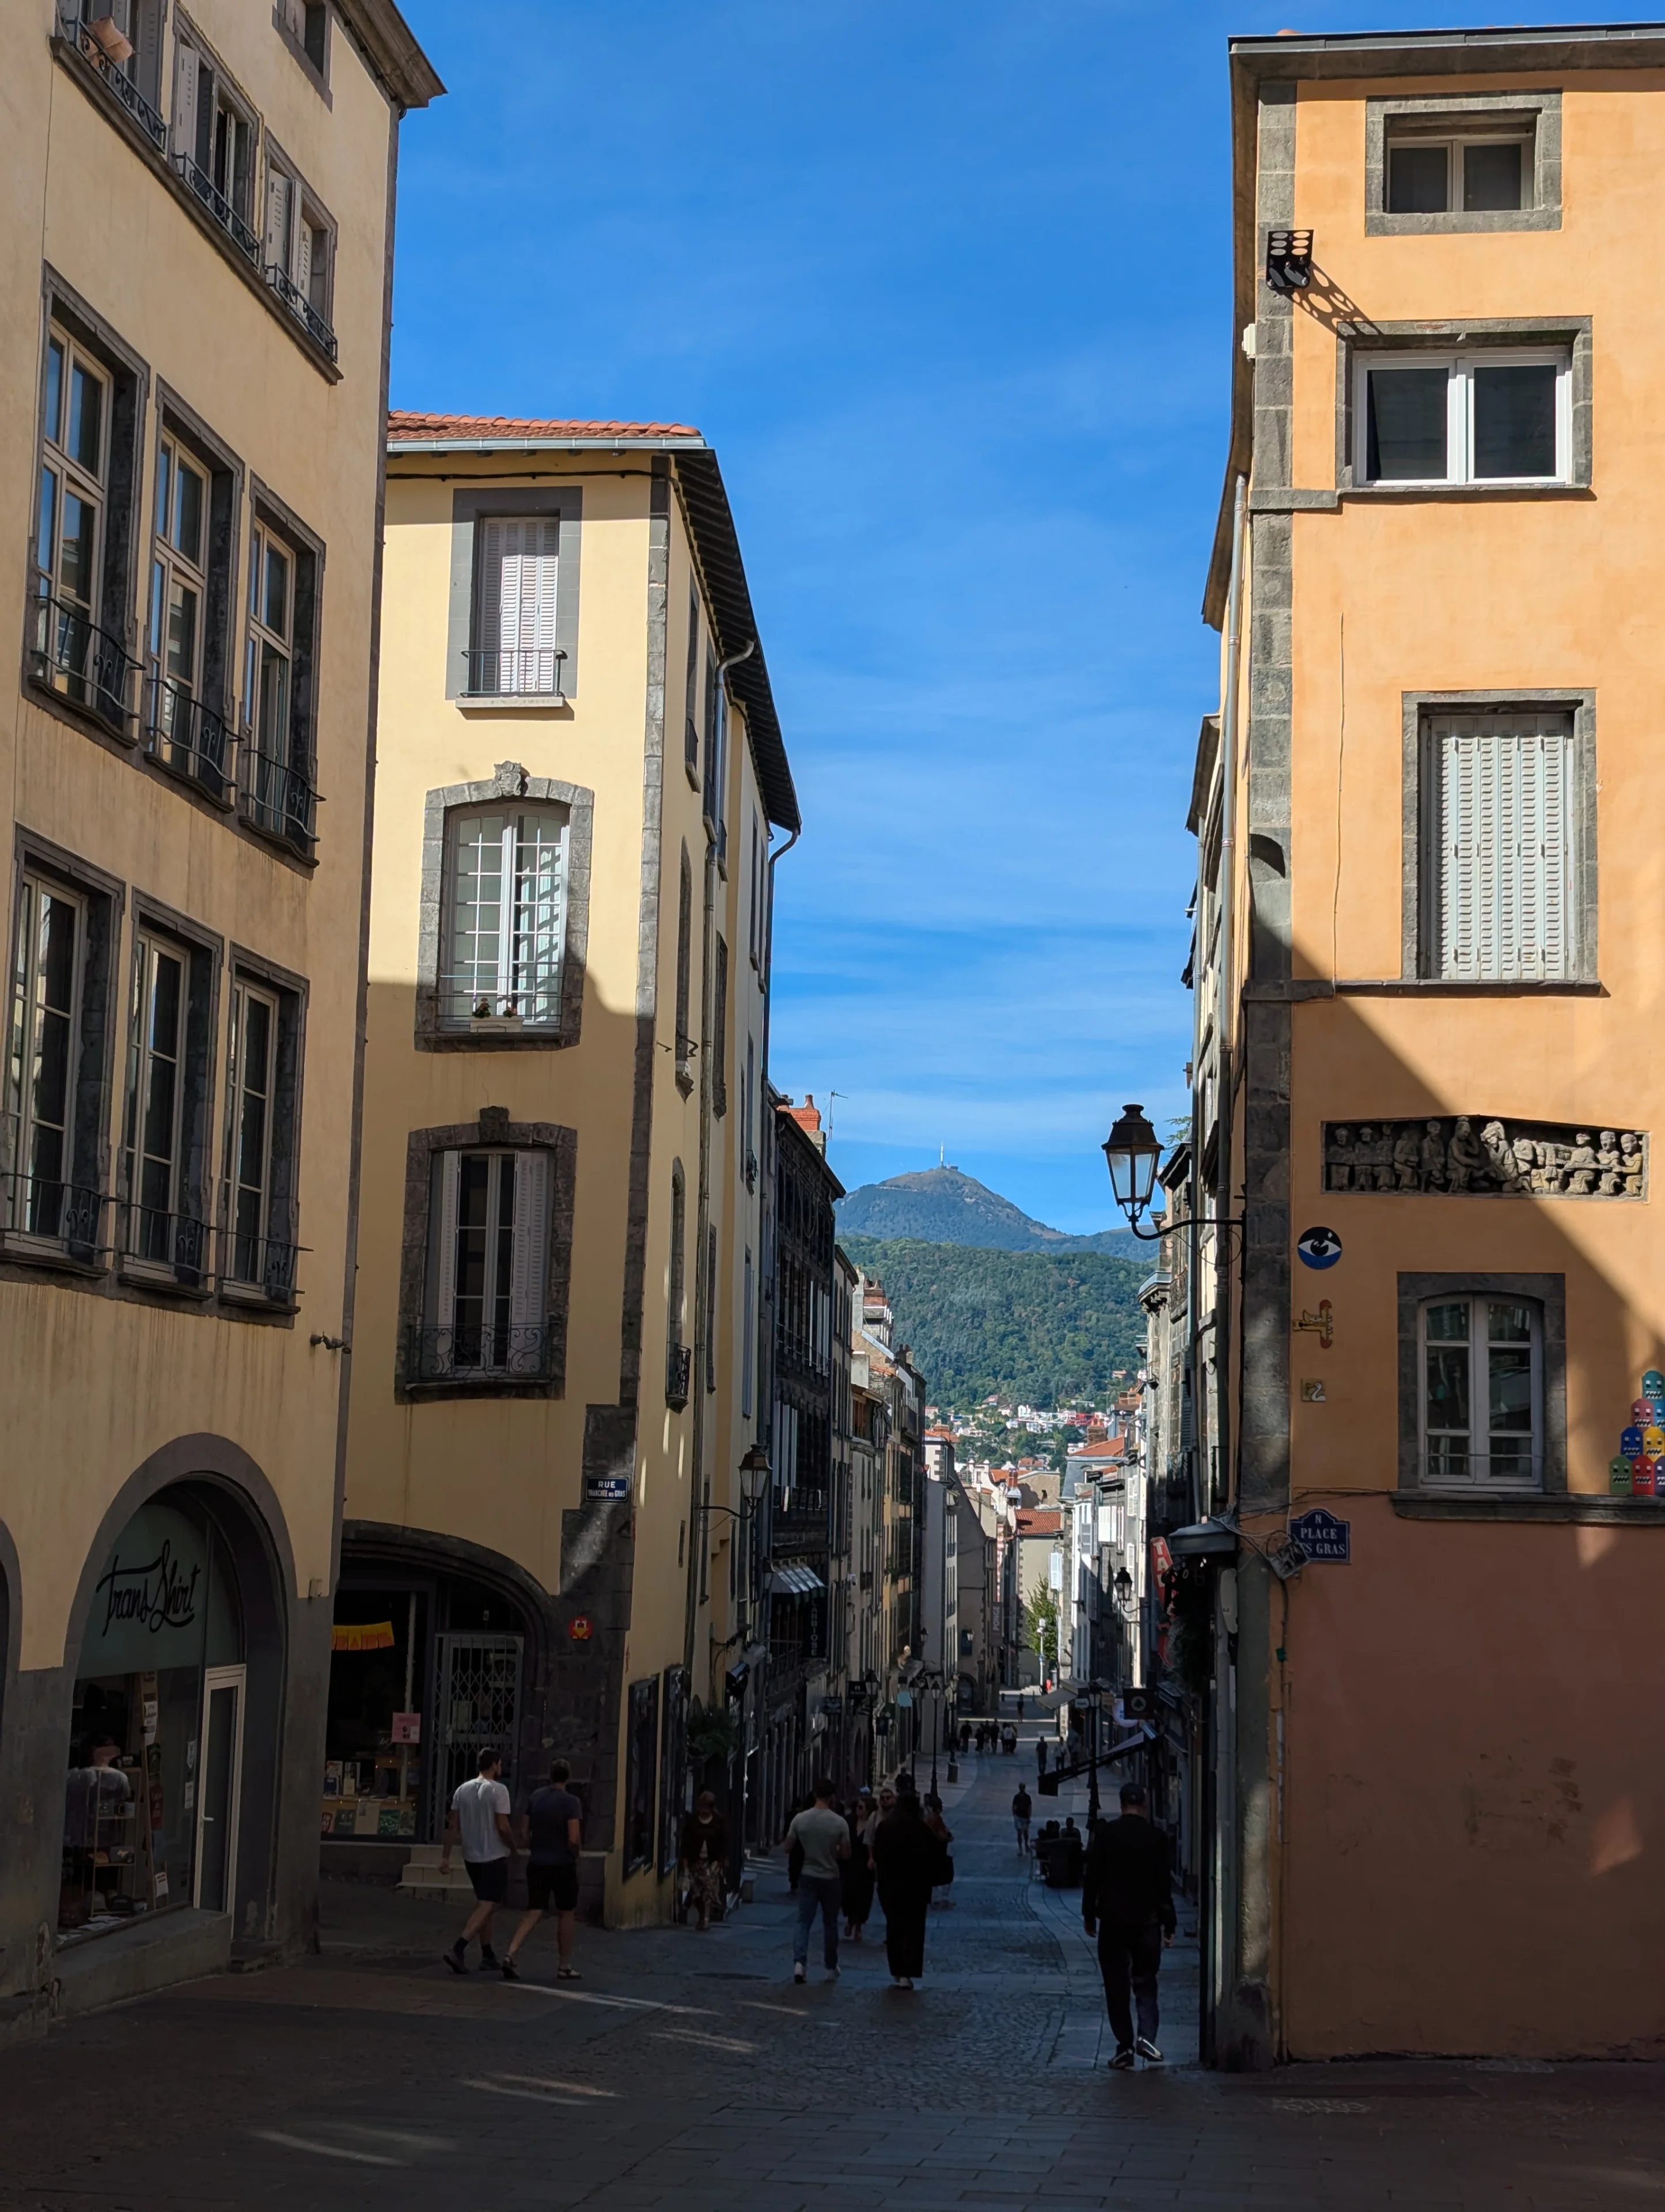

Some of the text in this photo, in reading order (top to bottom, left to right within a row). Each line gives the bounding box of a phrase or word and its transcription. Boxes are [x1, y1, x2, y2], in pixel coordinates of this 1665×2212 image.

[598, 1480, 616, 1488] RUE
[615, 1490, 625, 1498] GRAS
[1300, 1527, 1338, 1540] PLACE
[1316, 1543, 1345, 1555] GRAS
